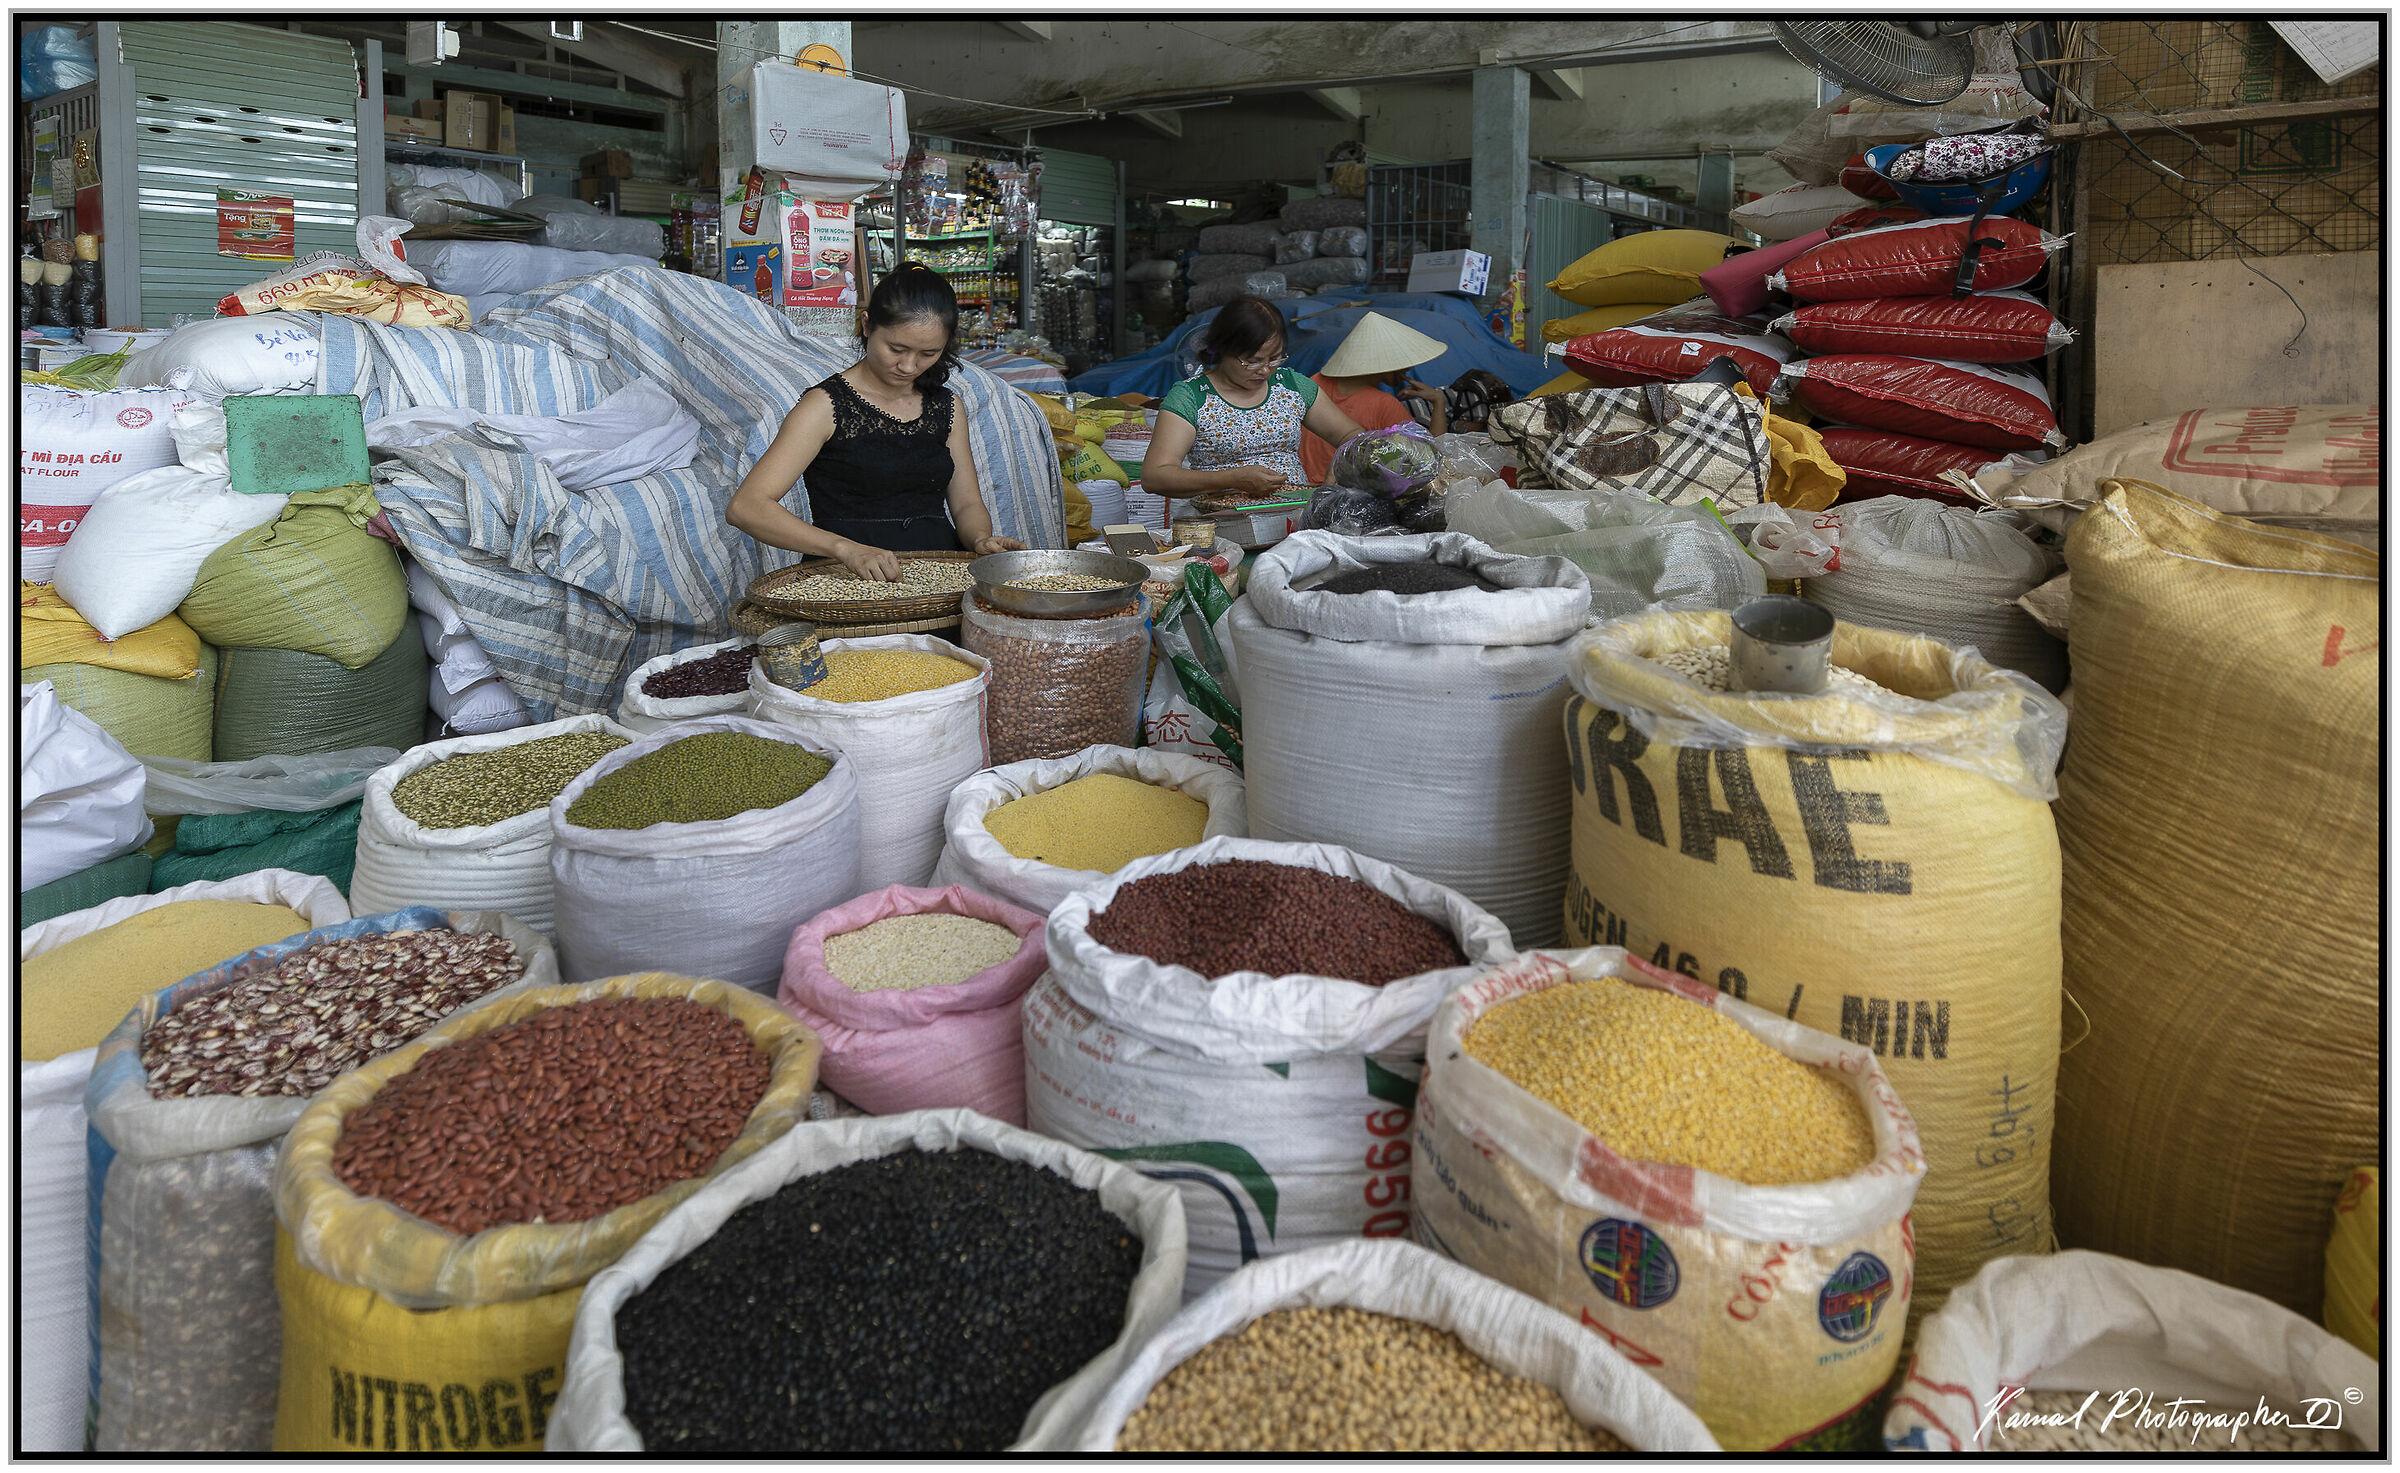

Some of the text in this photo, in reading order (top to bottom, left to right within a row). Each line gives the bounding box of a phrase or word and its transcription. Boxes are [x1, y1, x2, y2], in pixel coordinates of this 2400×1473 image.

[31, 450, 51, 464] MÌ
[56, 453, 84, 467] ĐỊA
[89, 450, 123, 464] CẦU
[37, 467, 80, 478] FLOUR
[1840, 994, 1952, 1061] MIN
